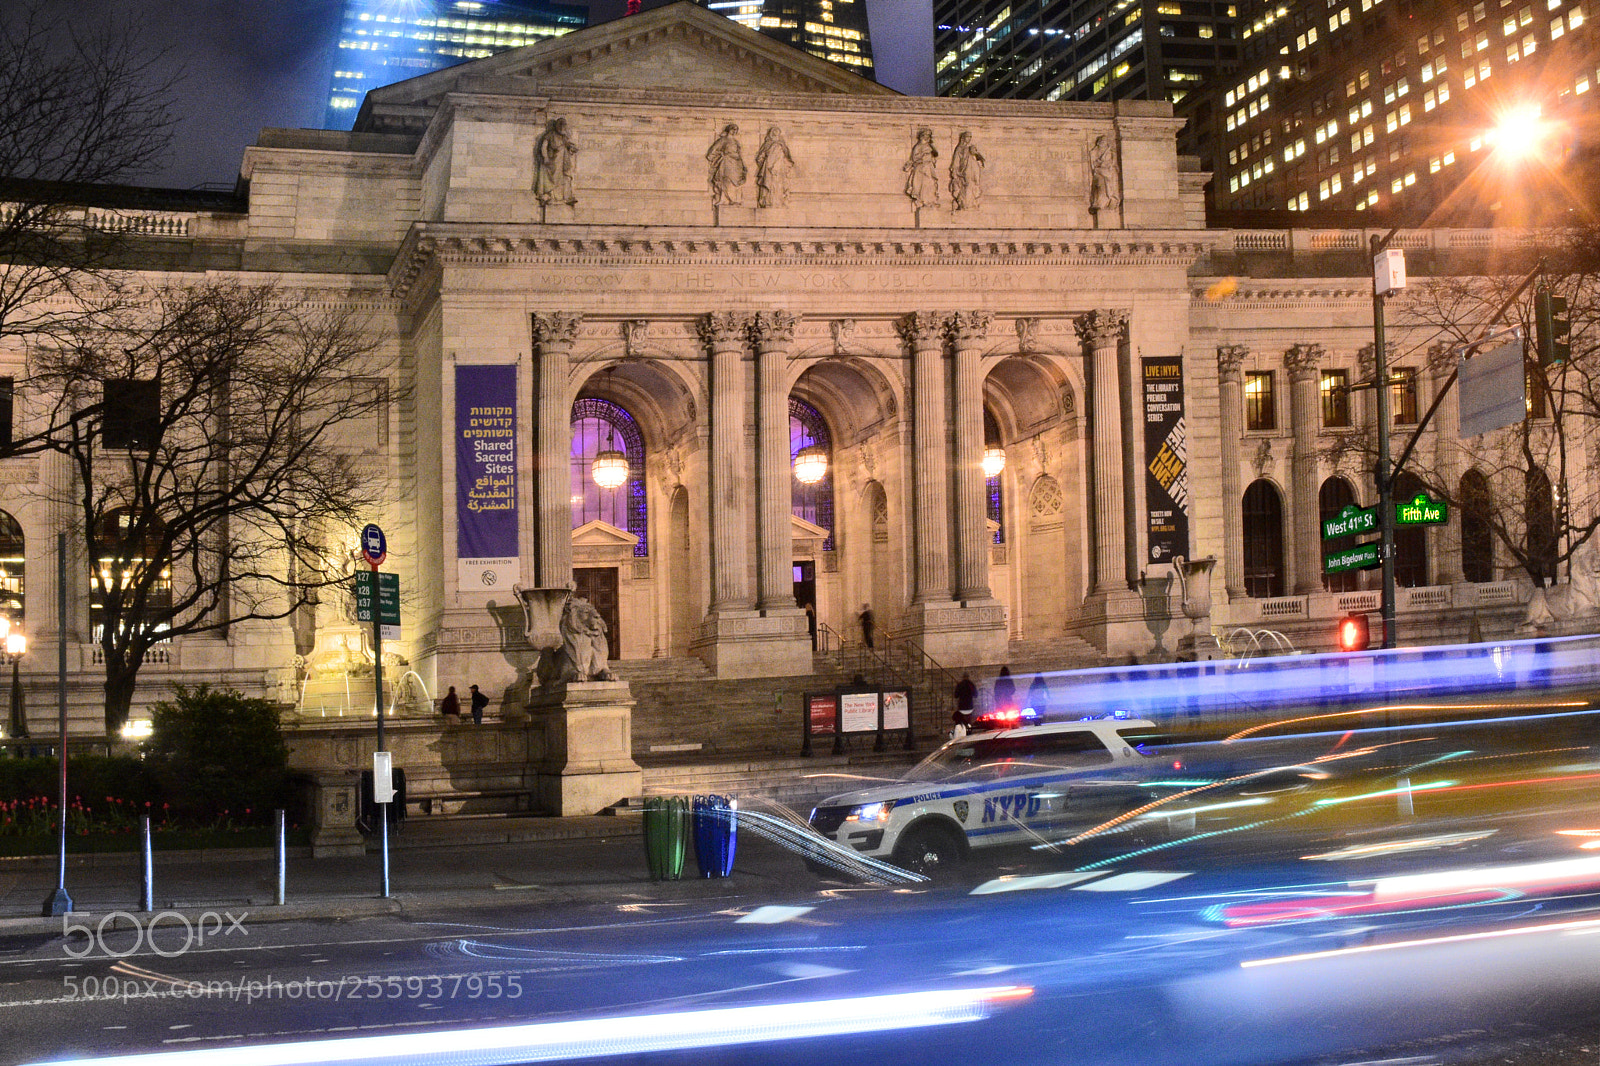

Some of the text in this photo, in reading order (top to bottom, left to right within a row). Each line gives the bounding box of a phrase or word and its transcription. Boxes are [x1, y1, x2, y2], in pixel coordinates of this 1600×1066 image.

[670, 273, 715, 288] THE
[731, 274, 781, 287] NEW
[800, 274, 850, 288] YORK
[867, 273, 933, 288] PUBLIC
[950, 273, 1024, 288] LIBRARY
[1145, 366, 1160, 376] LIVE
[1163, 365, 1180, 376] NYPL
[1146, 384, 1155, 392] THE
[470, 407, 512, 417] מקומות
[1147, 403, 1180, 412] CONVERSATION
[470, 418, 512, 427] קדושים
[1148, 413, 1163, 422] SERIES
[464, 430, 513, 438] משותפים
[474, 439, 513, 450] Shared
[475, 452, 513, 462] Sacred
[485, 464, 513, 474] Sites
[476, 475, 514, 489] المواقع
[469, 488, 514, 498] المقدسة
[467, 499, 514, 513] المشتركة
[1403, 507, 1440, 521] Fifth Ave
[1326, 521, 1347, 536] West
[1364, 514, 1373, 527] St
[1328, 558, 1340, 568] John
[1342, 553, 1364, 566] Bigelow
[914, 793, 940, 803] POLICE
[982, 792, 1041, 823] NYPD
